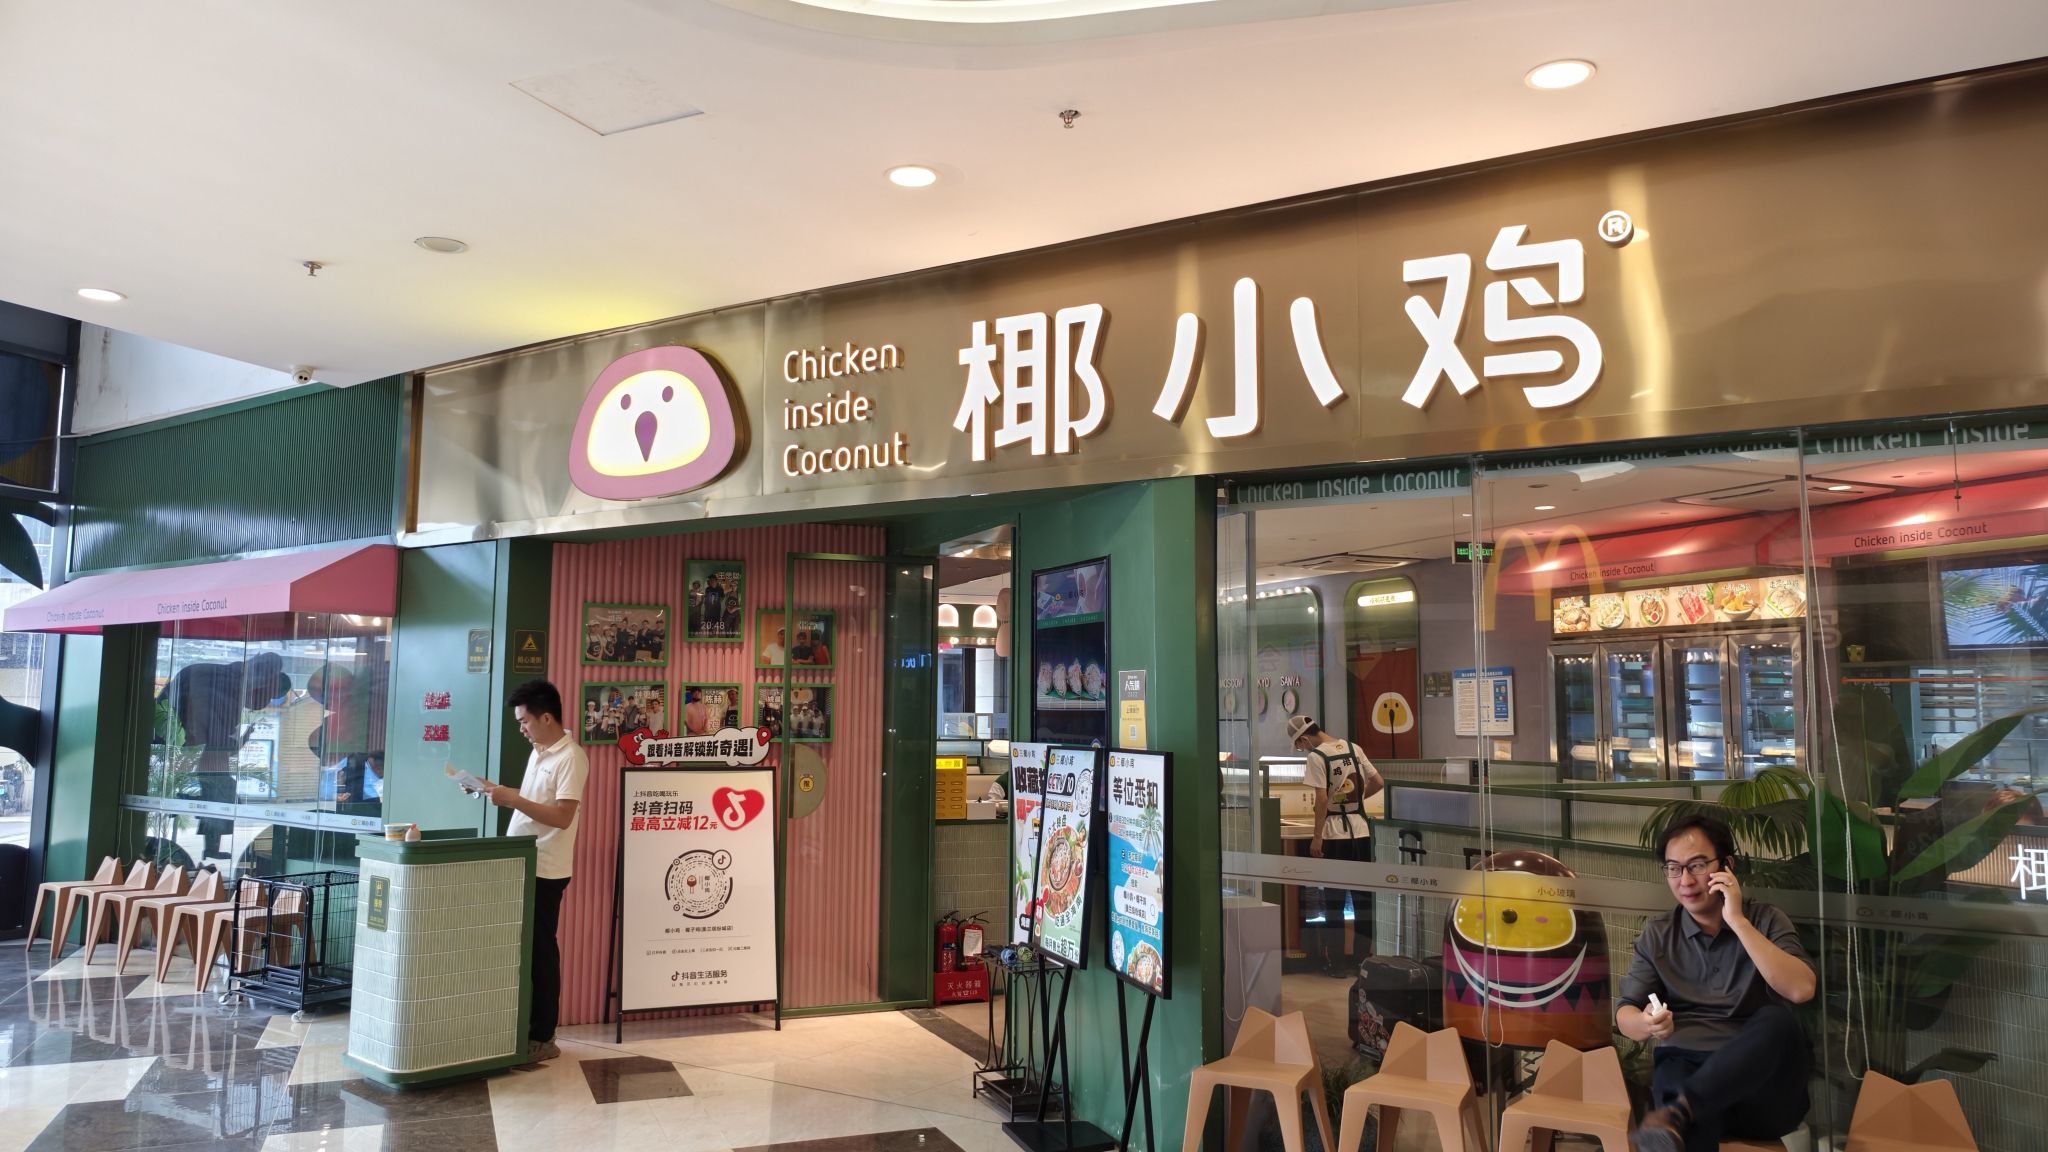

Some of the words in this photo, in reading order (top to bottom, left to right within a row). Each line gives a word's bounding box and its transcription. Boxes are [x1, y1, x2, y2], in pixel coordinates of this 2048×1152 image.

[952, 225, 1602, 462] 椰小鸡
[783, 343, 898, 383] Chicken
[783, 394, 869, 431] inside
[783, 433, 906, 478] Coconut
[1854, 535, 1895, 548] Chicken
[1899, 529, 1933, 543] inside
[1937, 522, 1988, 538] Coconut
[1623, 563, 1655, 576] Coconut
[157, 602, 181, 615] Chicken
[182, 600, 200, 612] inside
[201, 597, 228, 611] Coconut
[700, 621, 725, 631] 20:48
[1280, 675, 1301, 687] SANYA
[646, 737, 755, 759] 跟着抖音解锁新奇遇!
[632, 790, 679, 798] 上抖音吃喝玩乐
[1112, 775, 1159, 810] 等位悉知
[632, 800, 694, 816] 抖音扫码
[630, 815, 718, 832] 最高立减12元
[1410, 876, 1439, 888] 椰小鸡
[1537, 887, 1577, 899] 小心玻璃
[681, 969, 728, 981] 抖音生活服务
[947, 979, 981, 991] 灭火器箱
